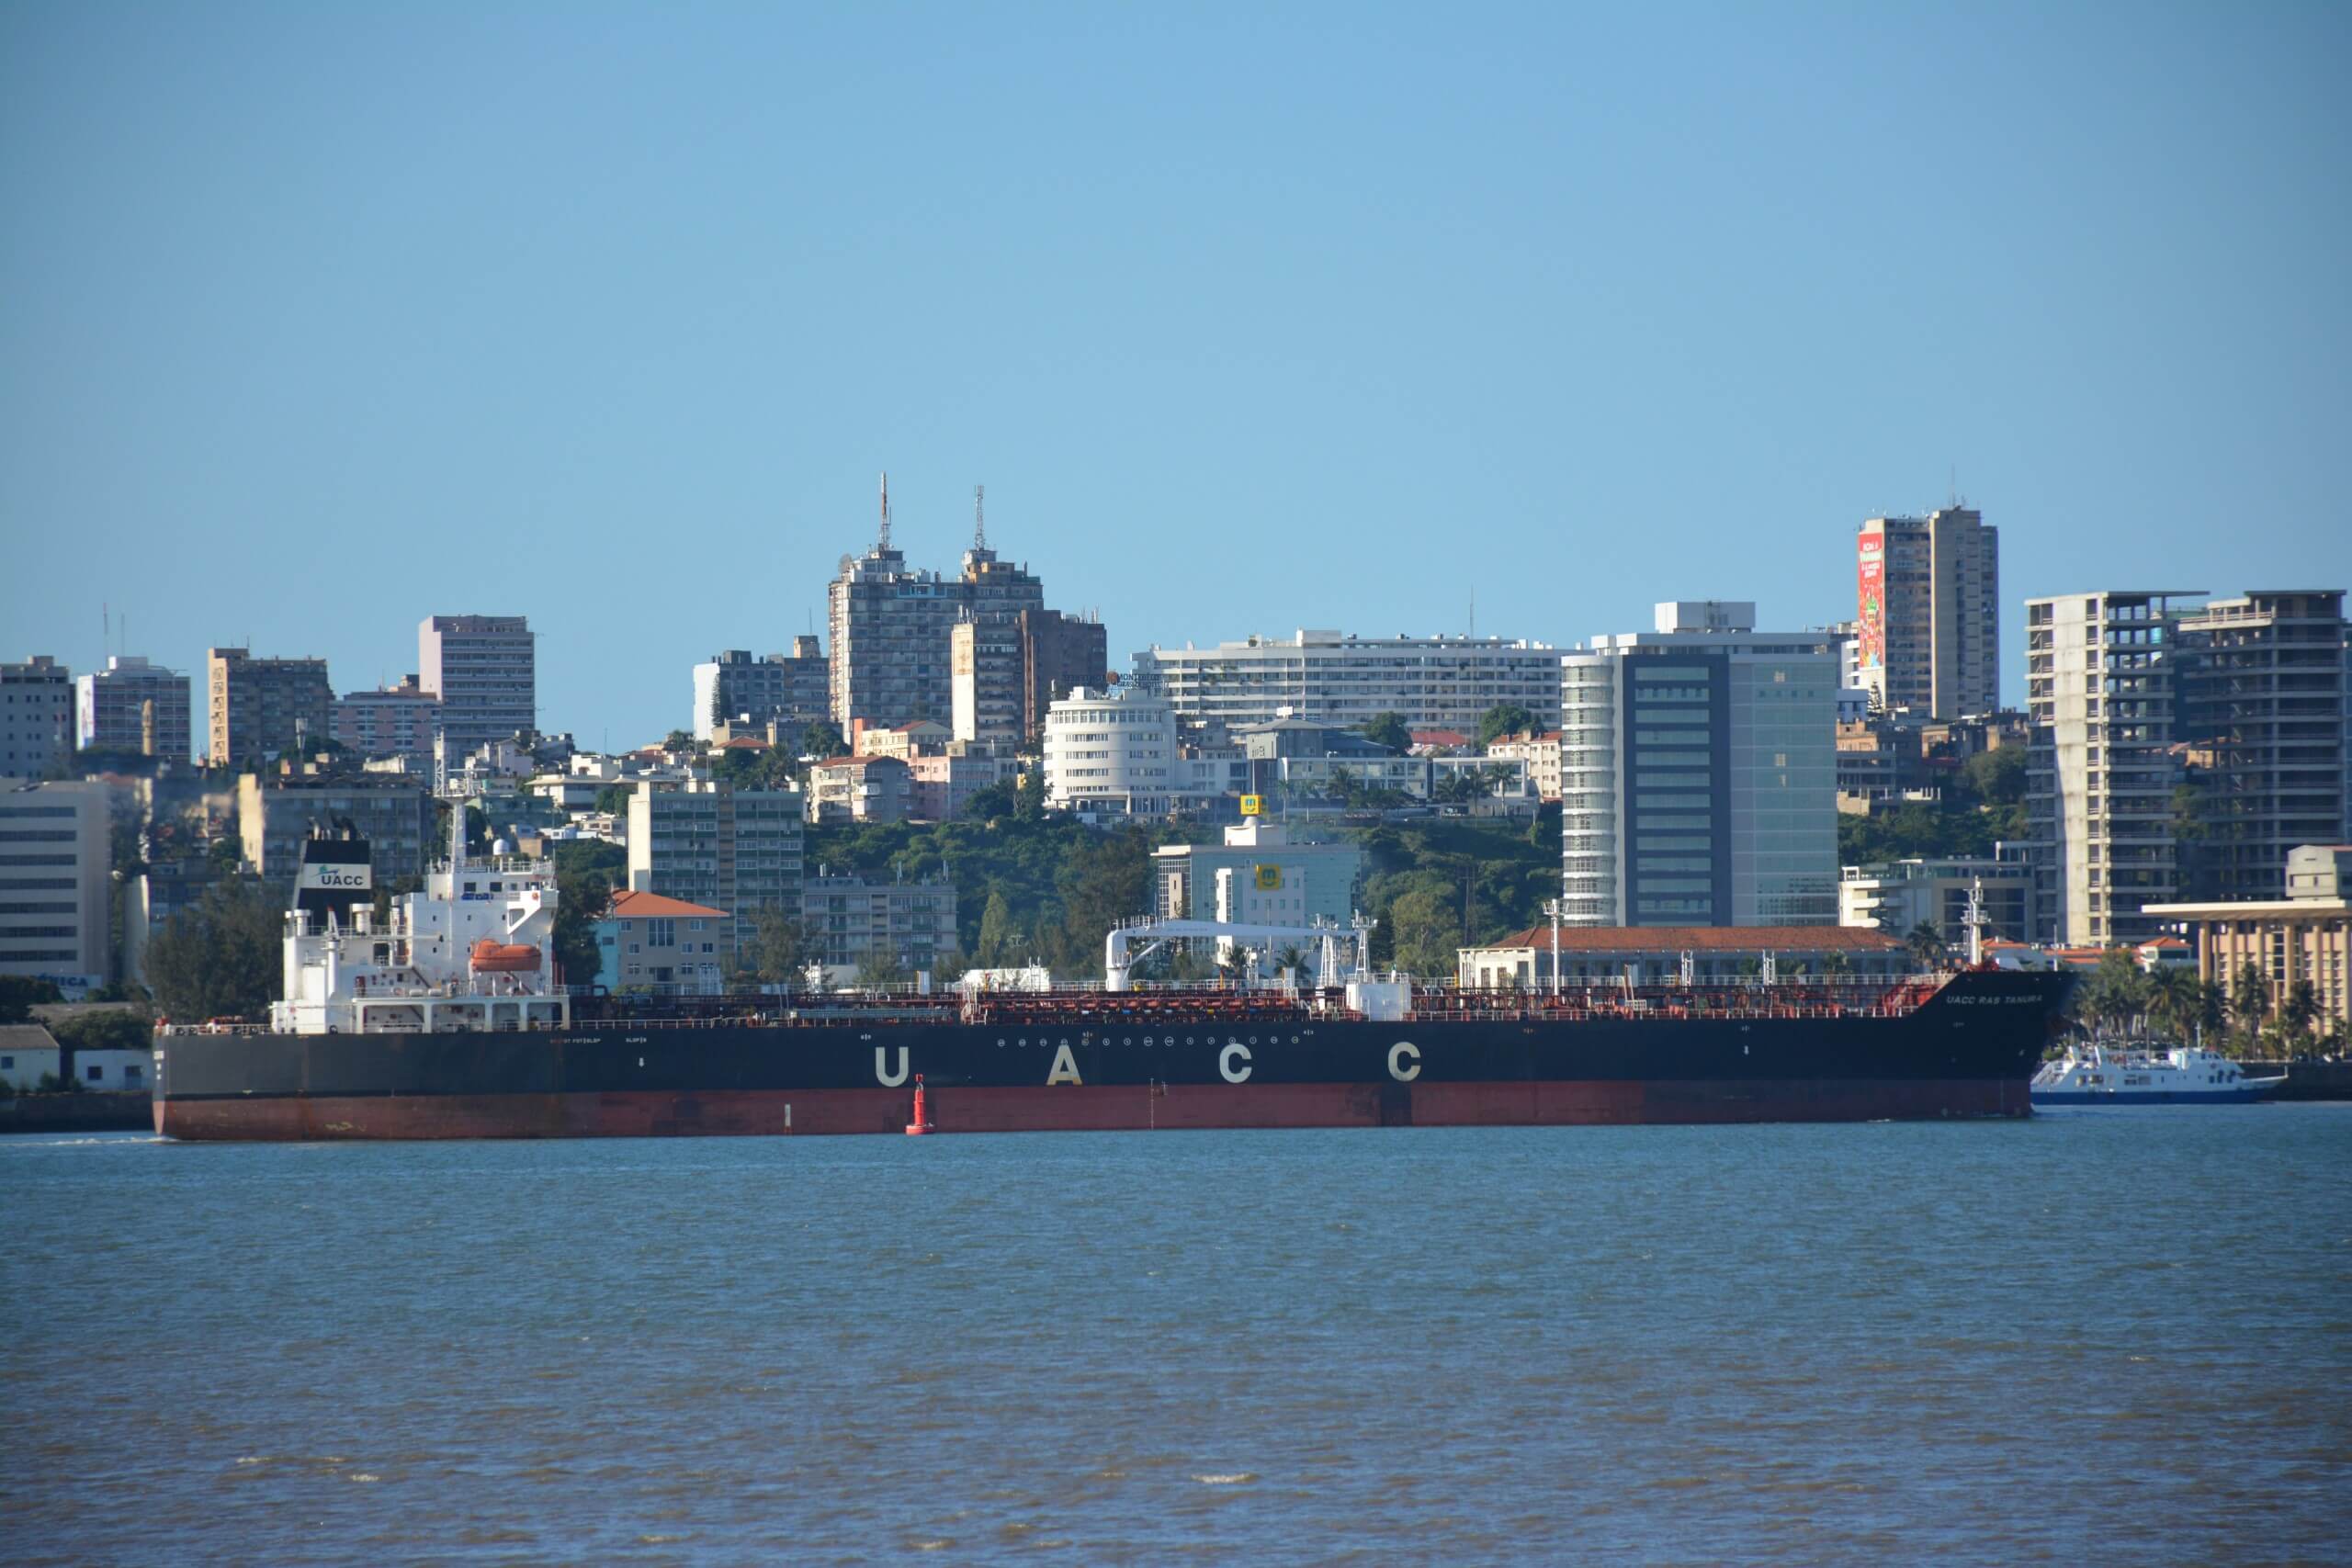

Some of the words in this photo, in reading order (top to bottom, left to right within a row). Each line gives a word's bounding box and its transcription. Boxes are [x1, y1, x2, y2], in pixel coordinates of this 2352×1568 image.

[322, 875, 364, 886] UACC
[1947, 996, 1976, 1004] UACC
[1979, 996, 2001, 1004] RAS
